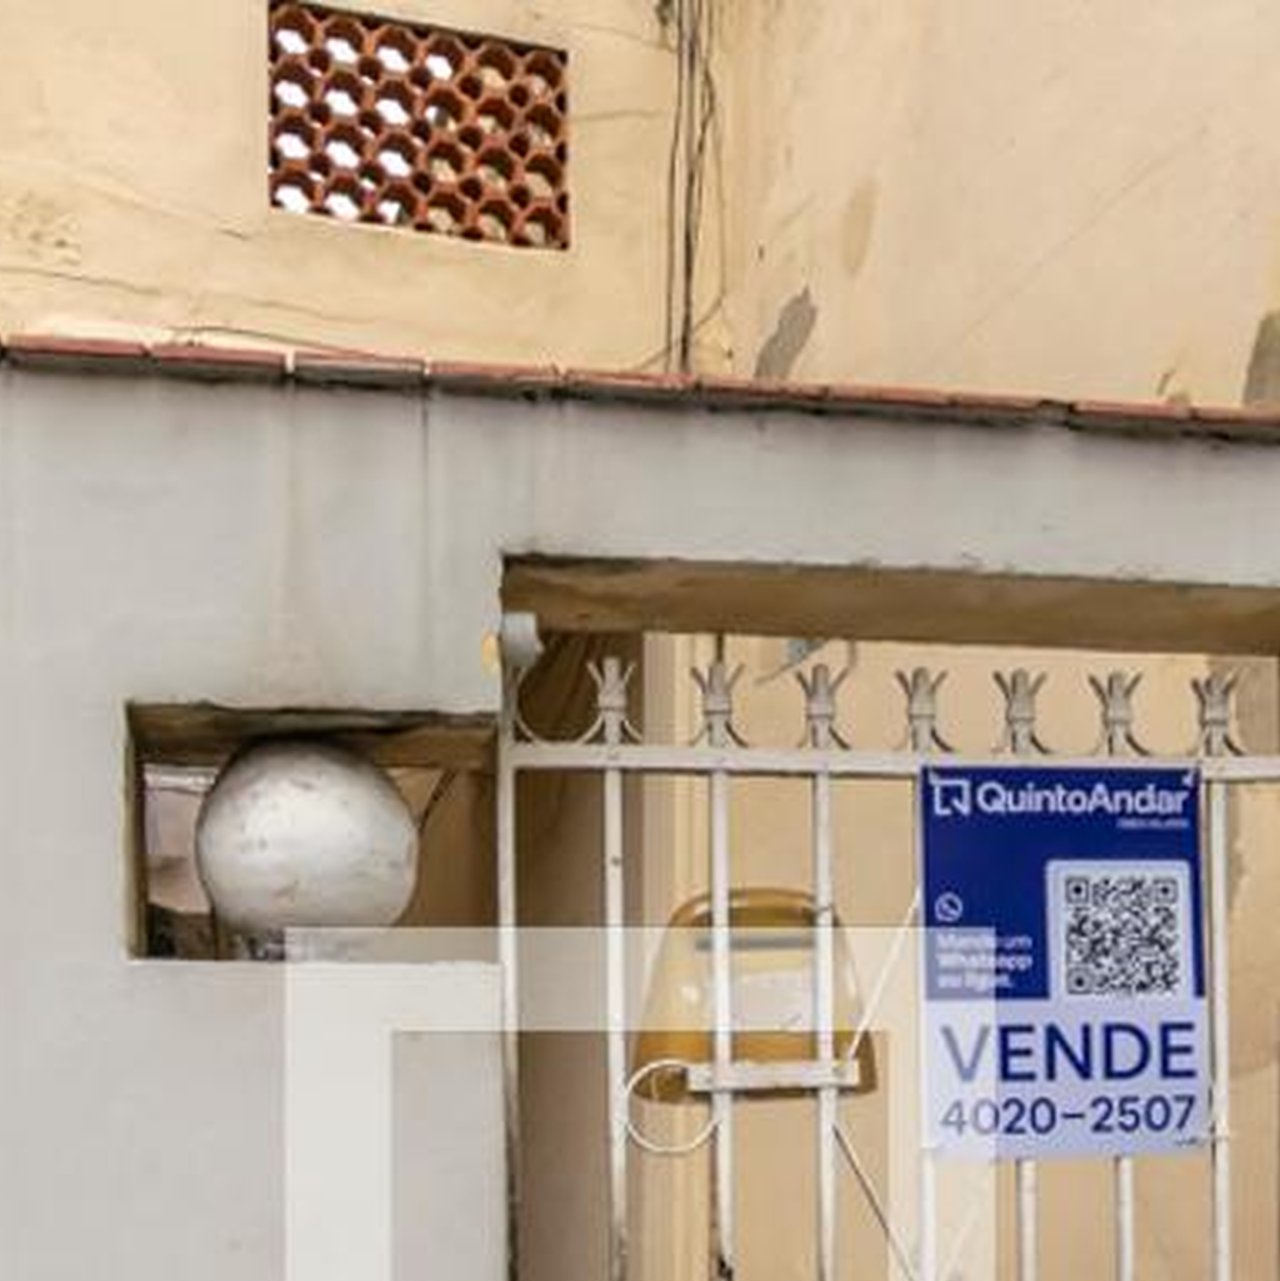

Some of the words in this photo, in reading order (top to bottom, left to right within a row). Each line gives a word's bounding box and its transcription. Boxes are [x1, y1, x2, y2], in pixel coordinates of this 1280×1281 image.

[976, 781, 1189, 815] QuintoAndar
[939, 1022, 1198, 1082] VENDE
[939, 1094, 1197, 1135] 4020-2507
